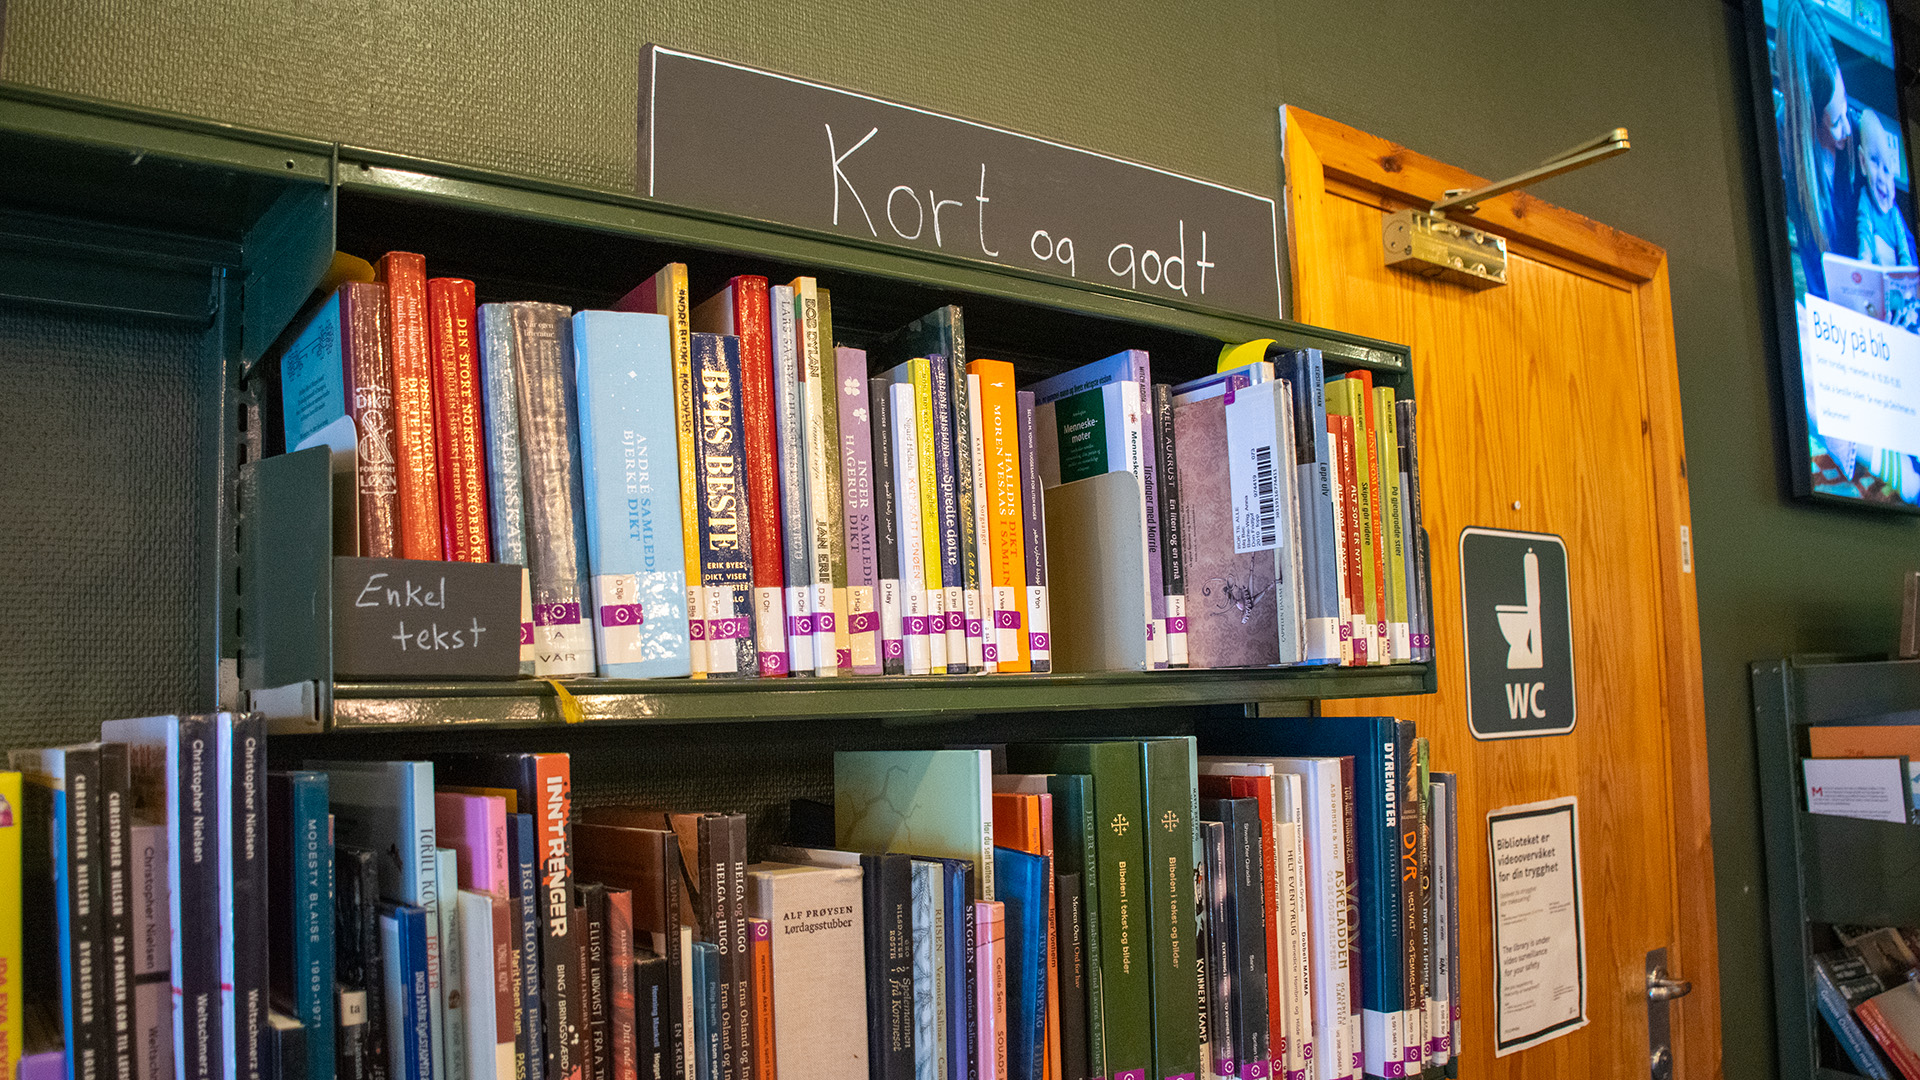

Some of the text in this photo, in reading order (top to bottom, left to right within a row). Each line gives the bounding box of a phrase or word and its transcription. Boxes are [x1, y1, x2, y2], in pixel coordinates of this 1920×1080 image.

[825, 123, 1215, 297] Kort og godt
[805, 298, 819, 378] BOB DYLAN
[1813, 311, 1847, 355] Baby
[1870, 329, 1890, 361] bib
[356, 394, 391, 408] DIKT
[457, 319, 474, 460] DEN STORE NORSKE
[408, 377, 423, 474] DETTE LIVET
[940, 411, 950, 457] IMISLUND
[994, 404, 1003, 456] MOREN
[360, 474, 396, 487] LØGN
[700, 369, 738, 551] BYES BESTE
[1166, 437, 1175, 487] AUKRUST
[621, 430, 640, 542] BJERKE DIKT
[846, 435, 859, 553] HAGERUP DIKT
[942, 475, 956, 527] Spredte
[998, 462, 1006, 516] VESAAS
[1005, 453, 1017, 557] HALLDIS DIKT
[1170, 499, 1176, 510] En
[1392, 486, 1399, 497] På
[858, 460, 872, 586] INGER SAMLEDE
[980, 504, 988, 546] Sorgsanger
[1354, 532, 1361, 545] ER
[1391, 498, 1400, 538] gjengrodde
[947, 529, 958, 565] døtre
[1171, 534, 1178, 546] og
[355, 573, 446, 608] Enkel
[705, 573, 724, 581] DIKT,
[1172, 561, 1180, 580] små
[392, 617, 488, 651] tekst
[553, 631, 564, 640] A
[539, 652, 576, 664] VAR
[1505, 682, 1546, 720] WC
[1384, 742, 1395, 827] DYREMØTER
[546, 776, 567, 938] INNTRENGER
[1403, 831, 1417, 882] DYR
[1497, 834, 1550, 850] Biblioteket er
[1498, 848, 1556, 866] videoovervåket
[1118, 861, 1127, 898] Bibelen
[1168, 856, 1177, 894] Bibelen
[1498, 862, 1558, 882] for din trygghet
[109, 792, 128, 1054] CHRISTOPHER NIELSEN DA KOM TIL
[191, 740, 209, 1075] Christopher Nielsen Weltschmerz
[243, 737, 260, 1070] Christopher Nielsen Weltschmerz
[308, 820, 321, 1028] MODESTY BLAISE 1969-1971
[783, 906, 853, 920] ALF PRØYSEN
[1120, 904, 1128, 929] tekst
[1170, 900, 1178, 924] tekst
[1335, 870, 1348, 970] ASKELADDEN
[1408, 914, 1416, 930] VILT
[784, 918, 852, 934] Lørdagsstubber
[1120, 931, 1128, 943] og
[1170, 926, 1178, 938] og
[521, 863, 540, 1056] JEG ER KLOVNEN Elisabeth
[716, 863, 732, 1066] HELGA og HUGO Erna Osland og
[734, 862, 750, 1064] HELGA og HUGO Erna Osland og
[1122, 946, 1131, 974] bilder
[1170, 940, 1179, 969] bilder
[512, 949, 523, 1035] Marit Hoem Kvam
[557, 964, 566, 992] BING
[966, 905, 976, 1055] SKYGGEN Veronica Salinas
[1036, 934, 1047, 1028] TUVA SYNNEVÅG
[1196, 957, 1206, 1004] KVINNER
[558, 1000, 570, 1070] BRINGSVÆRD
[1198, 1012, 1207, 1042] KAMP
